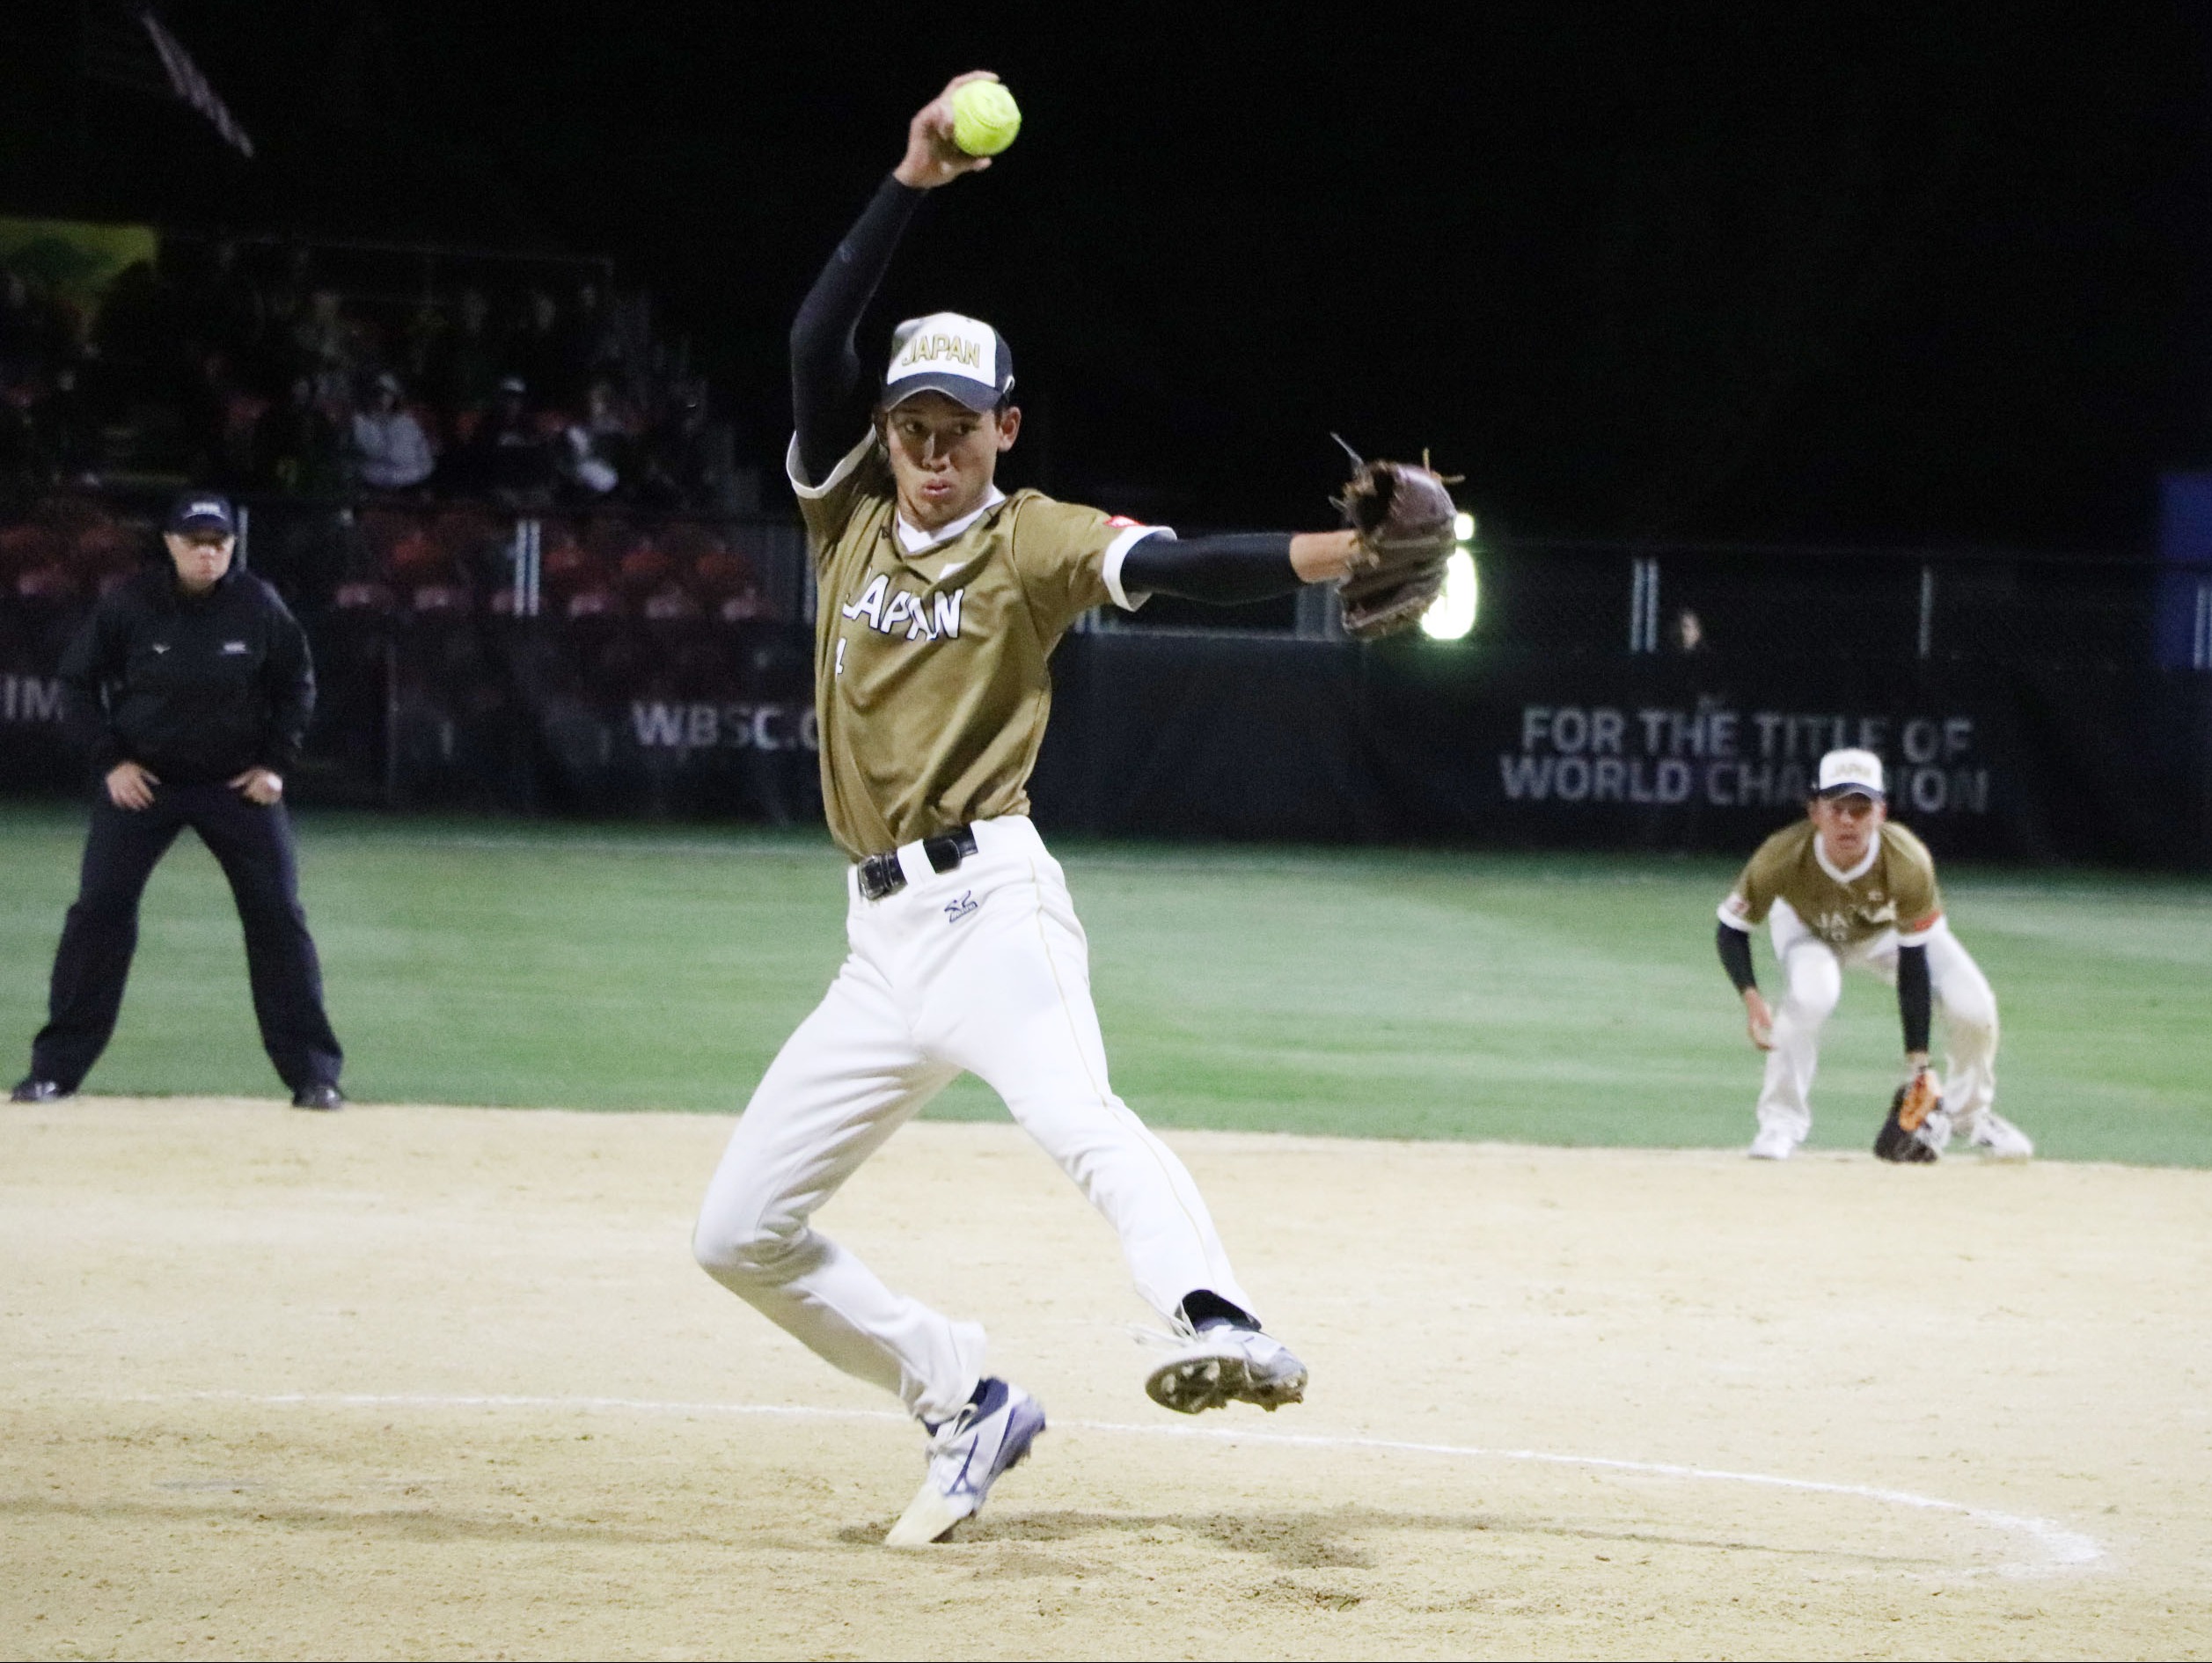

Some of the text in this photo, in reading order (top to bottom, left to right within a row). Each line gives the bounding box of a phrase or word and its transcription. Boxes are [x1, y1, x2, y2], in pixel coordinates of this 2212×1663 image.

[901, 333, 981, 369] JAPAN
[1520, 706, 1626, 755] FOR
[1638, 707, 1740, 757] THE
[1901, 714, 1974, 766] OF
[1498, 754, 1990, 815] WORLD CHAION
